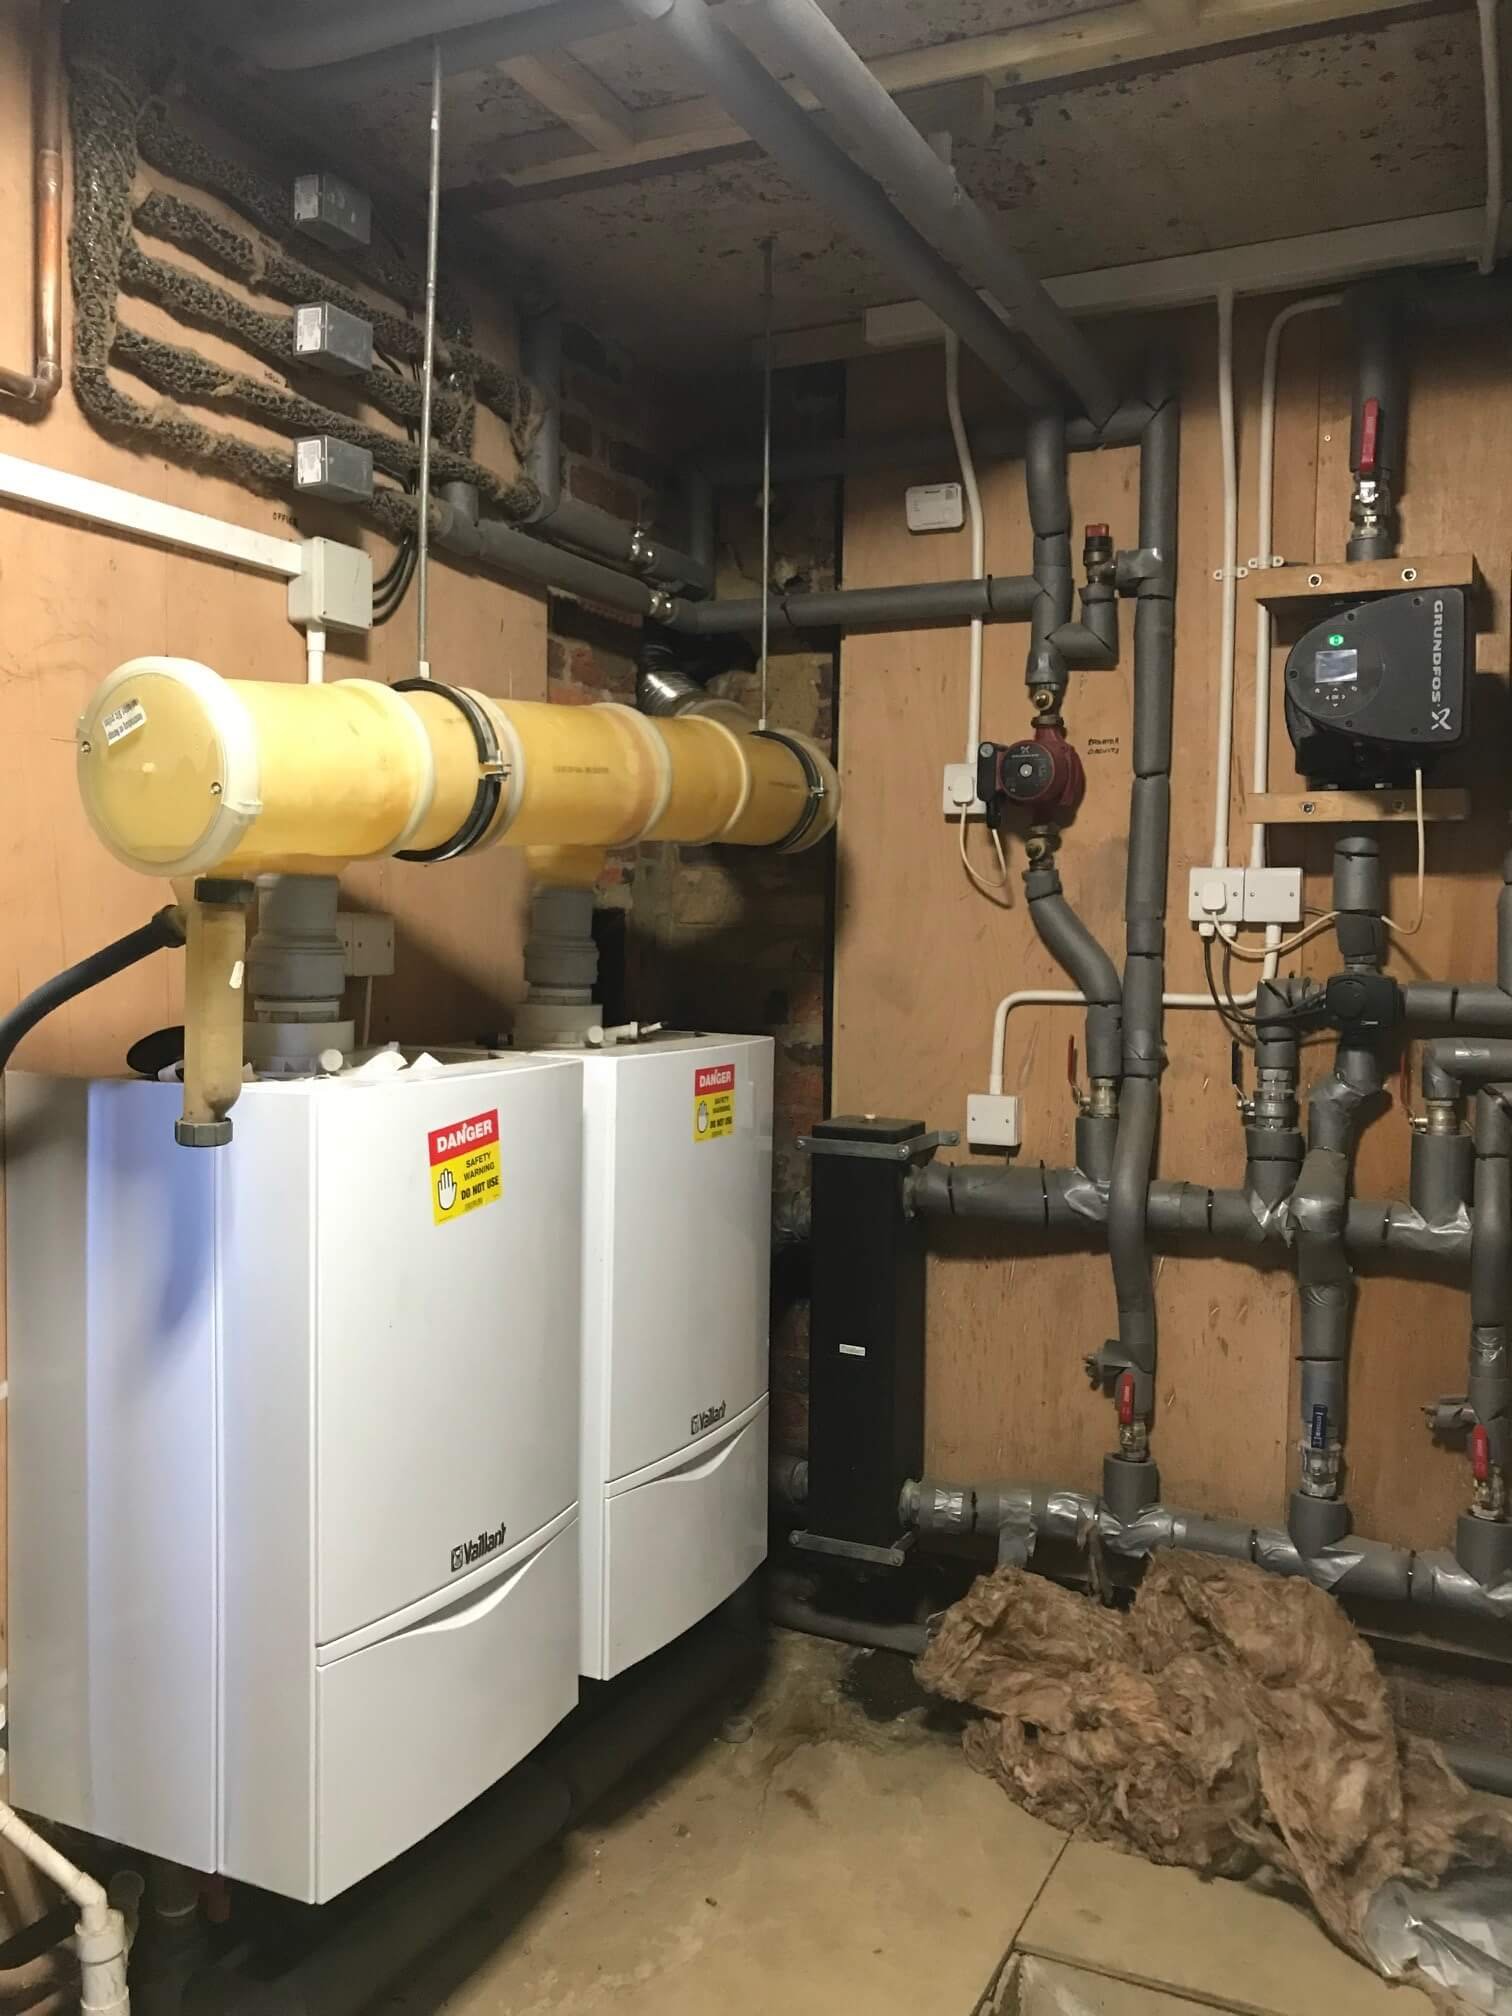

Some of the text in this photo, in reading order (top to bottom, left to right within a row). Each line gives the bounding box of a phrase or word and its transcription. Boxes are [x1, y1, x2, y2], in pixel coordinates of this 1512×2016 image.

[1431, 599, 1444, 703] GRUNDFOS
[699, 1070, 732, 1088] DANGER
[436, 1119, 493, 1153] DANGER
[463, 1162, 495, 1181] WARNING
[465, 1152, 491, 1168] SAFETY
[461, 1175, 499, 1200] DO NOT USE
[699, 1400, 726, 1430] Vaillant
[463, 1522, 507, 1564] Vaillant
